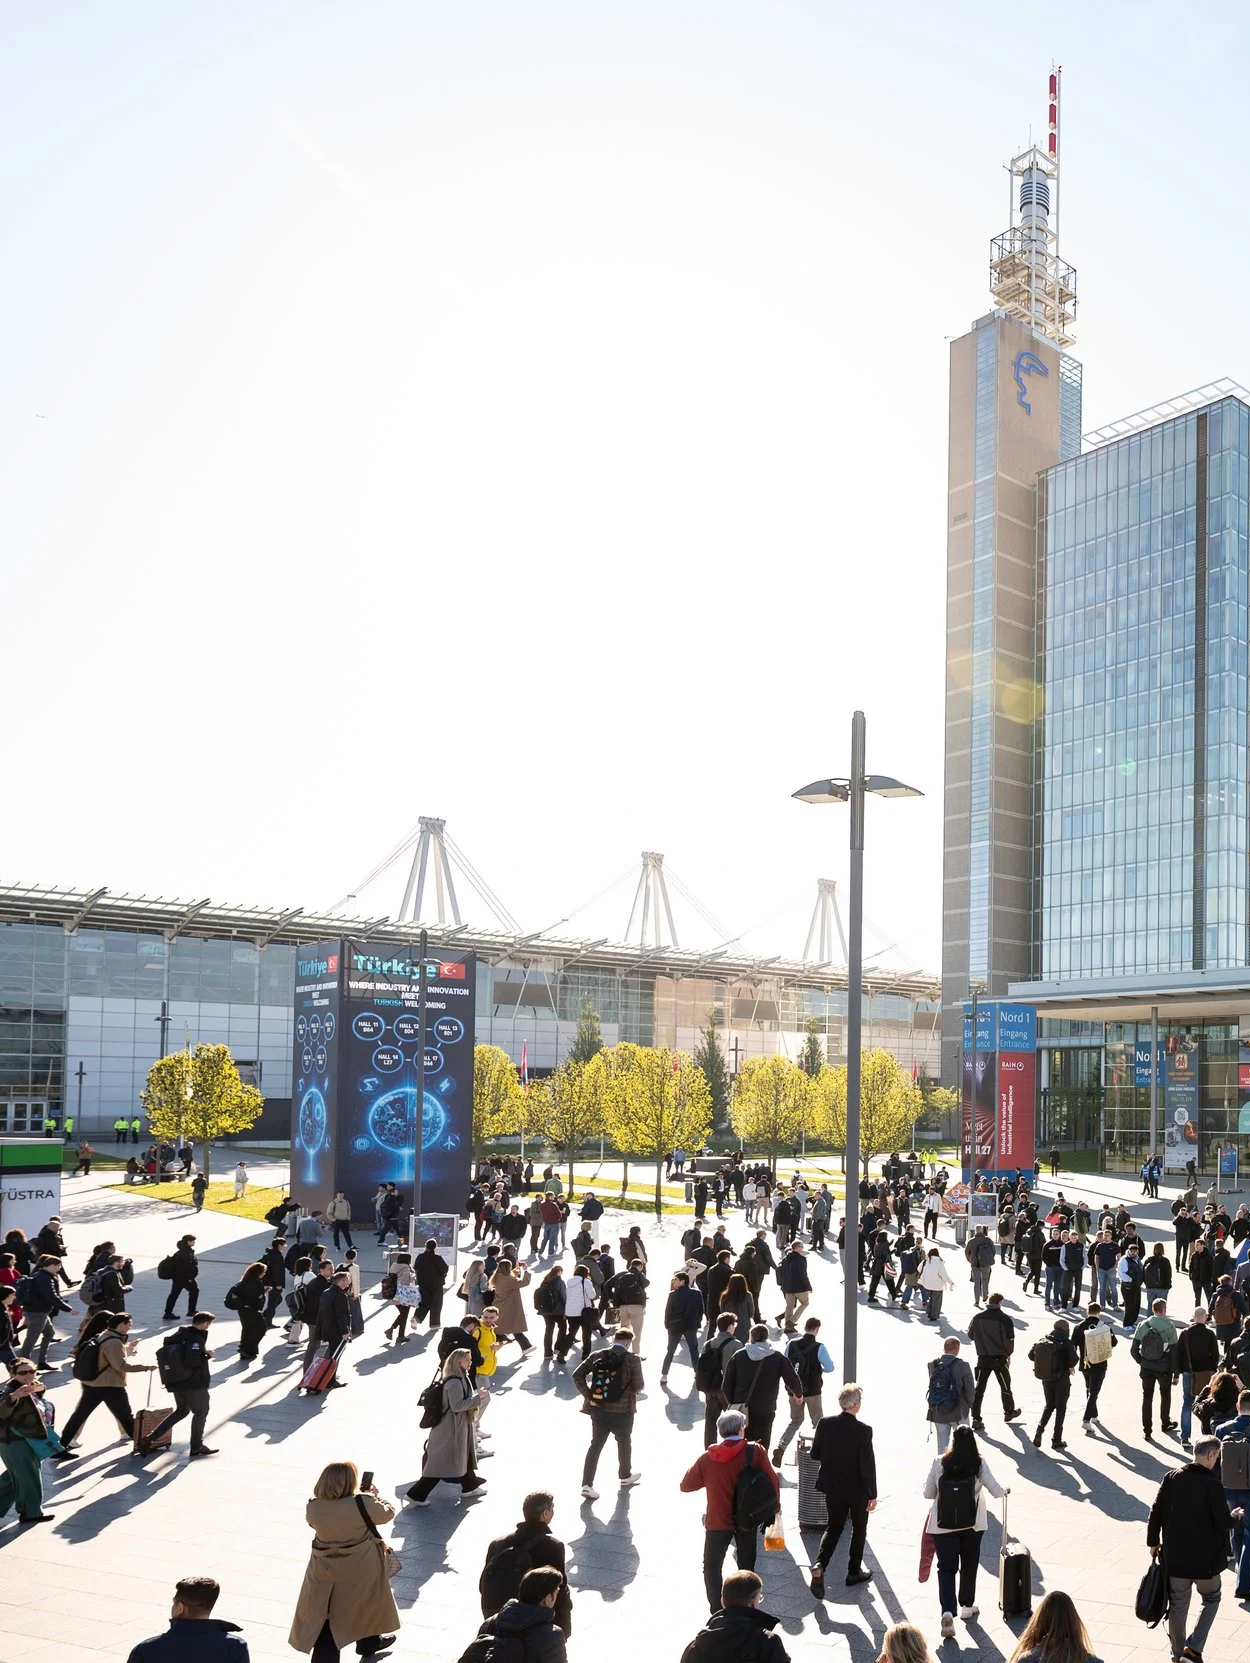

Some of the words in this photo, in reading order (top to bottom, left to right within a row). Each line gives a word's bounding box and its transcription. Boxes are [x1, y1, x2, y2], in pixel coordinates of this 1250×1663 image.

[348, 981, 374, 990] WHERE
[376, 982, 410, 992] INDUSTRY
[427, 986, 469, 995] INNOVATION
[1000, 1011, 1023, 1023] Nord
[1026, 1012, 1030, 1023] 1
[1000, 1029, 1028, 1040] Eingang
[1000, 1040, 1030, 1048] Entrance
[1162, 1050, 1166, 1061] 1
[965, 1145, 980, 1154] Hll
[981, 1146, 991, 1154] 27
[8, 1188, 54, 1200] ÜSTRA
